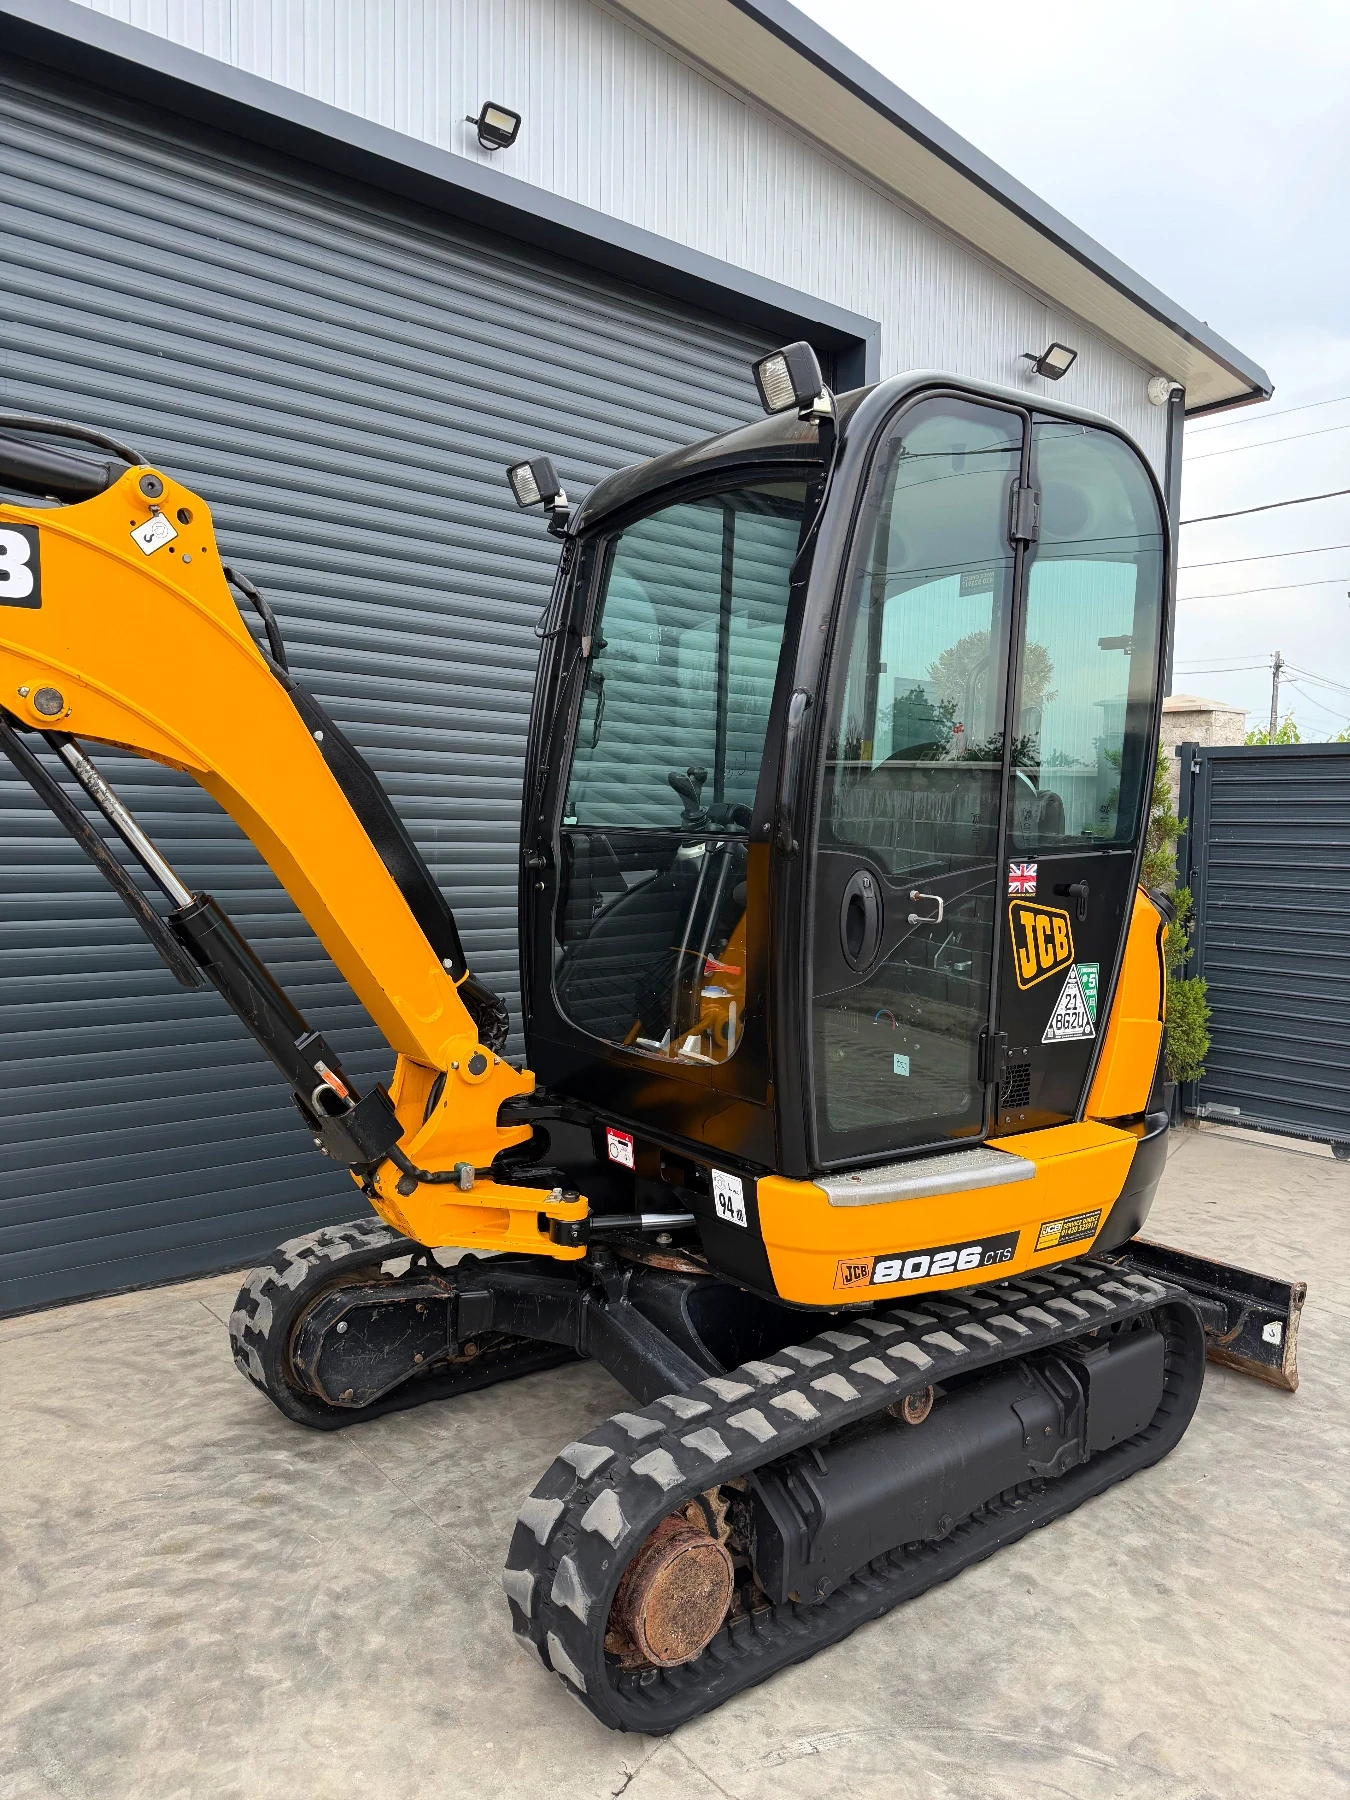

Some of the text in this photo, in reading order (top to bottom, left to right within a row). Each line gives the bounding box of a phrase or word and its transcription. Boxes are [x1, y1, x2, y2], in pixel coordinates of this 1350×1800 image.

[1019, 910, 1069, 979] JCB
[1065, 993, 1078, 1011] 21
[719, 1192, 735, 1219] 94
[844, 1246, 1012, 1284] JCB 8026 CTS
